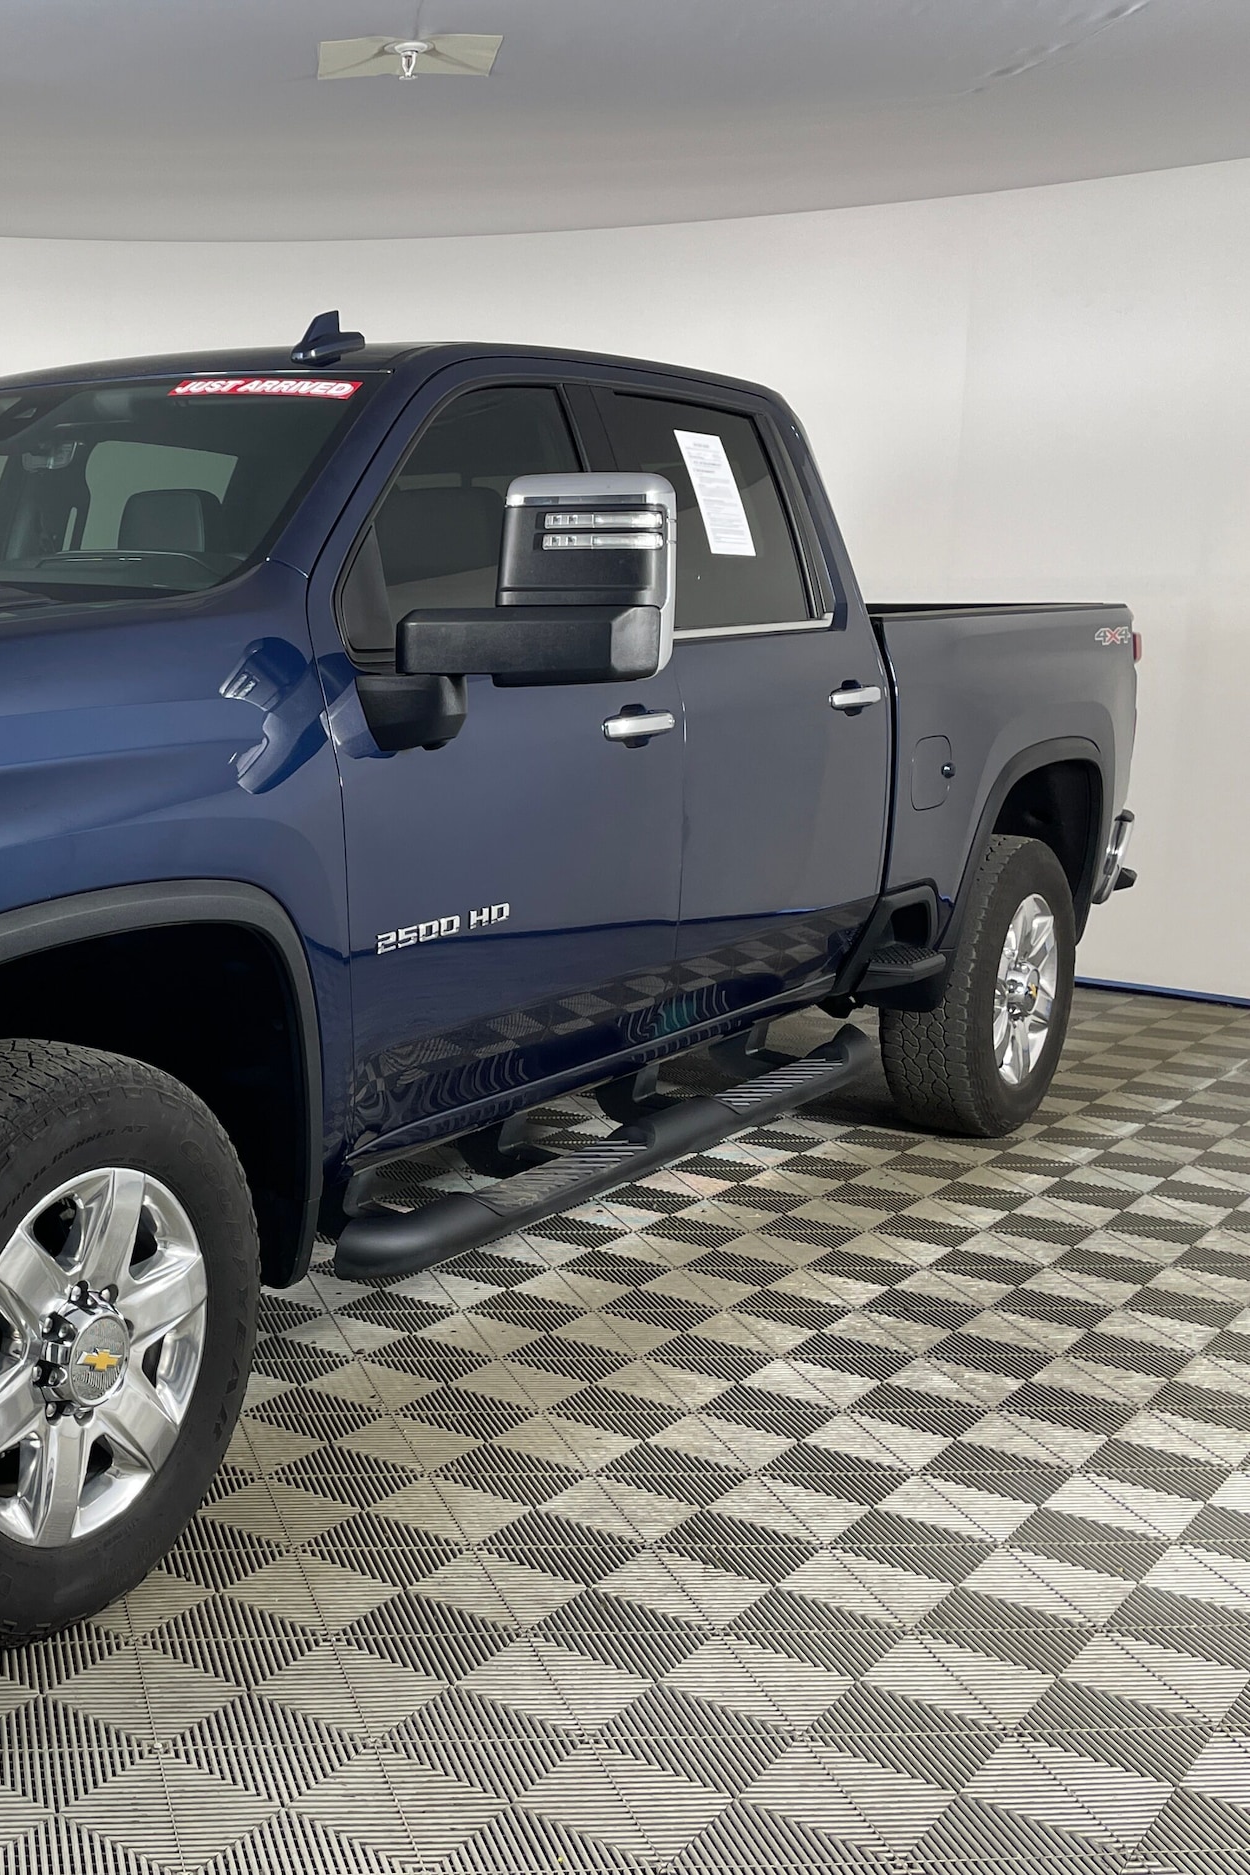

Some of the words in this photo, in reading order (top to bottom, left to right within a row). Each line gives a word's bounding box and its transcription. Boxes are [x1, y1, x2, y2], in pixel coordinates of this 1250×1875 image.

[175, 379, 238, 394] JUST
[237, 379, 354, 397] ARRIVED
[376, 914, 461, 955] 2500
[468, 902, 511, 930] HD
[0, 1165, 47, 1220] TRAIL
[52, 1128, 116, 1165] RUNNER
[120, 1124, 149, 1134] AT
[179, 1138, 249, 1444] GOODYEAR
